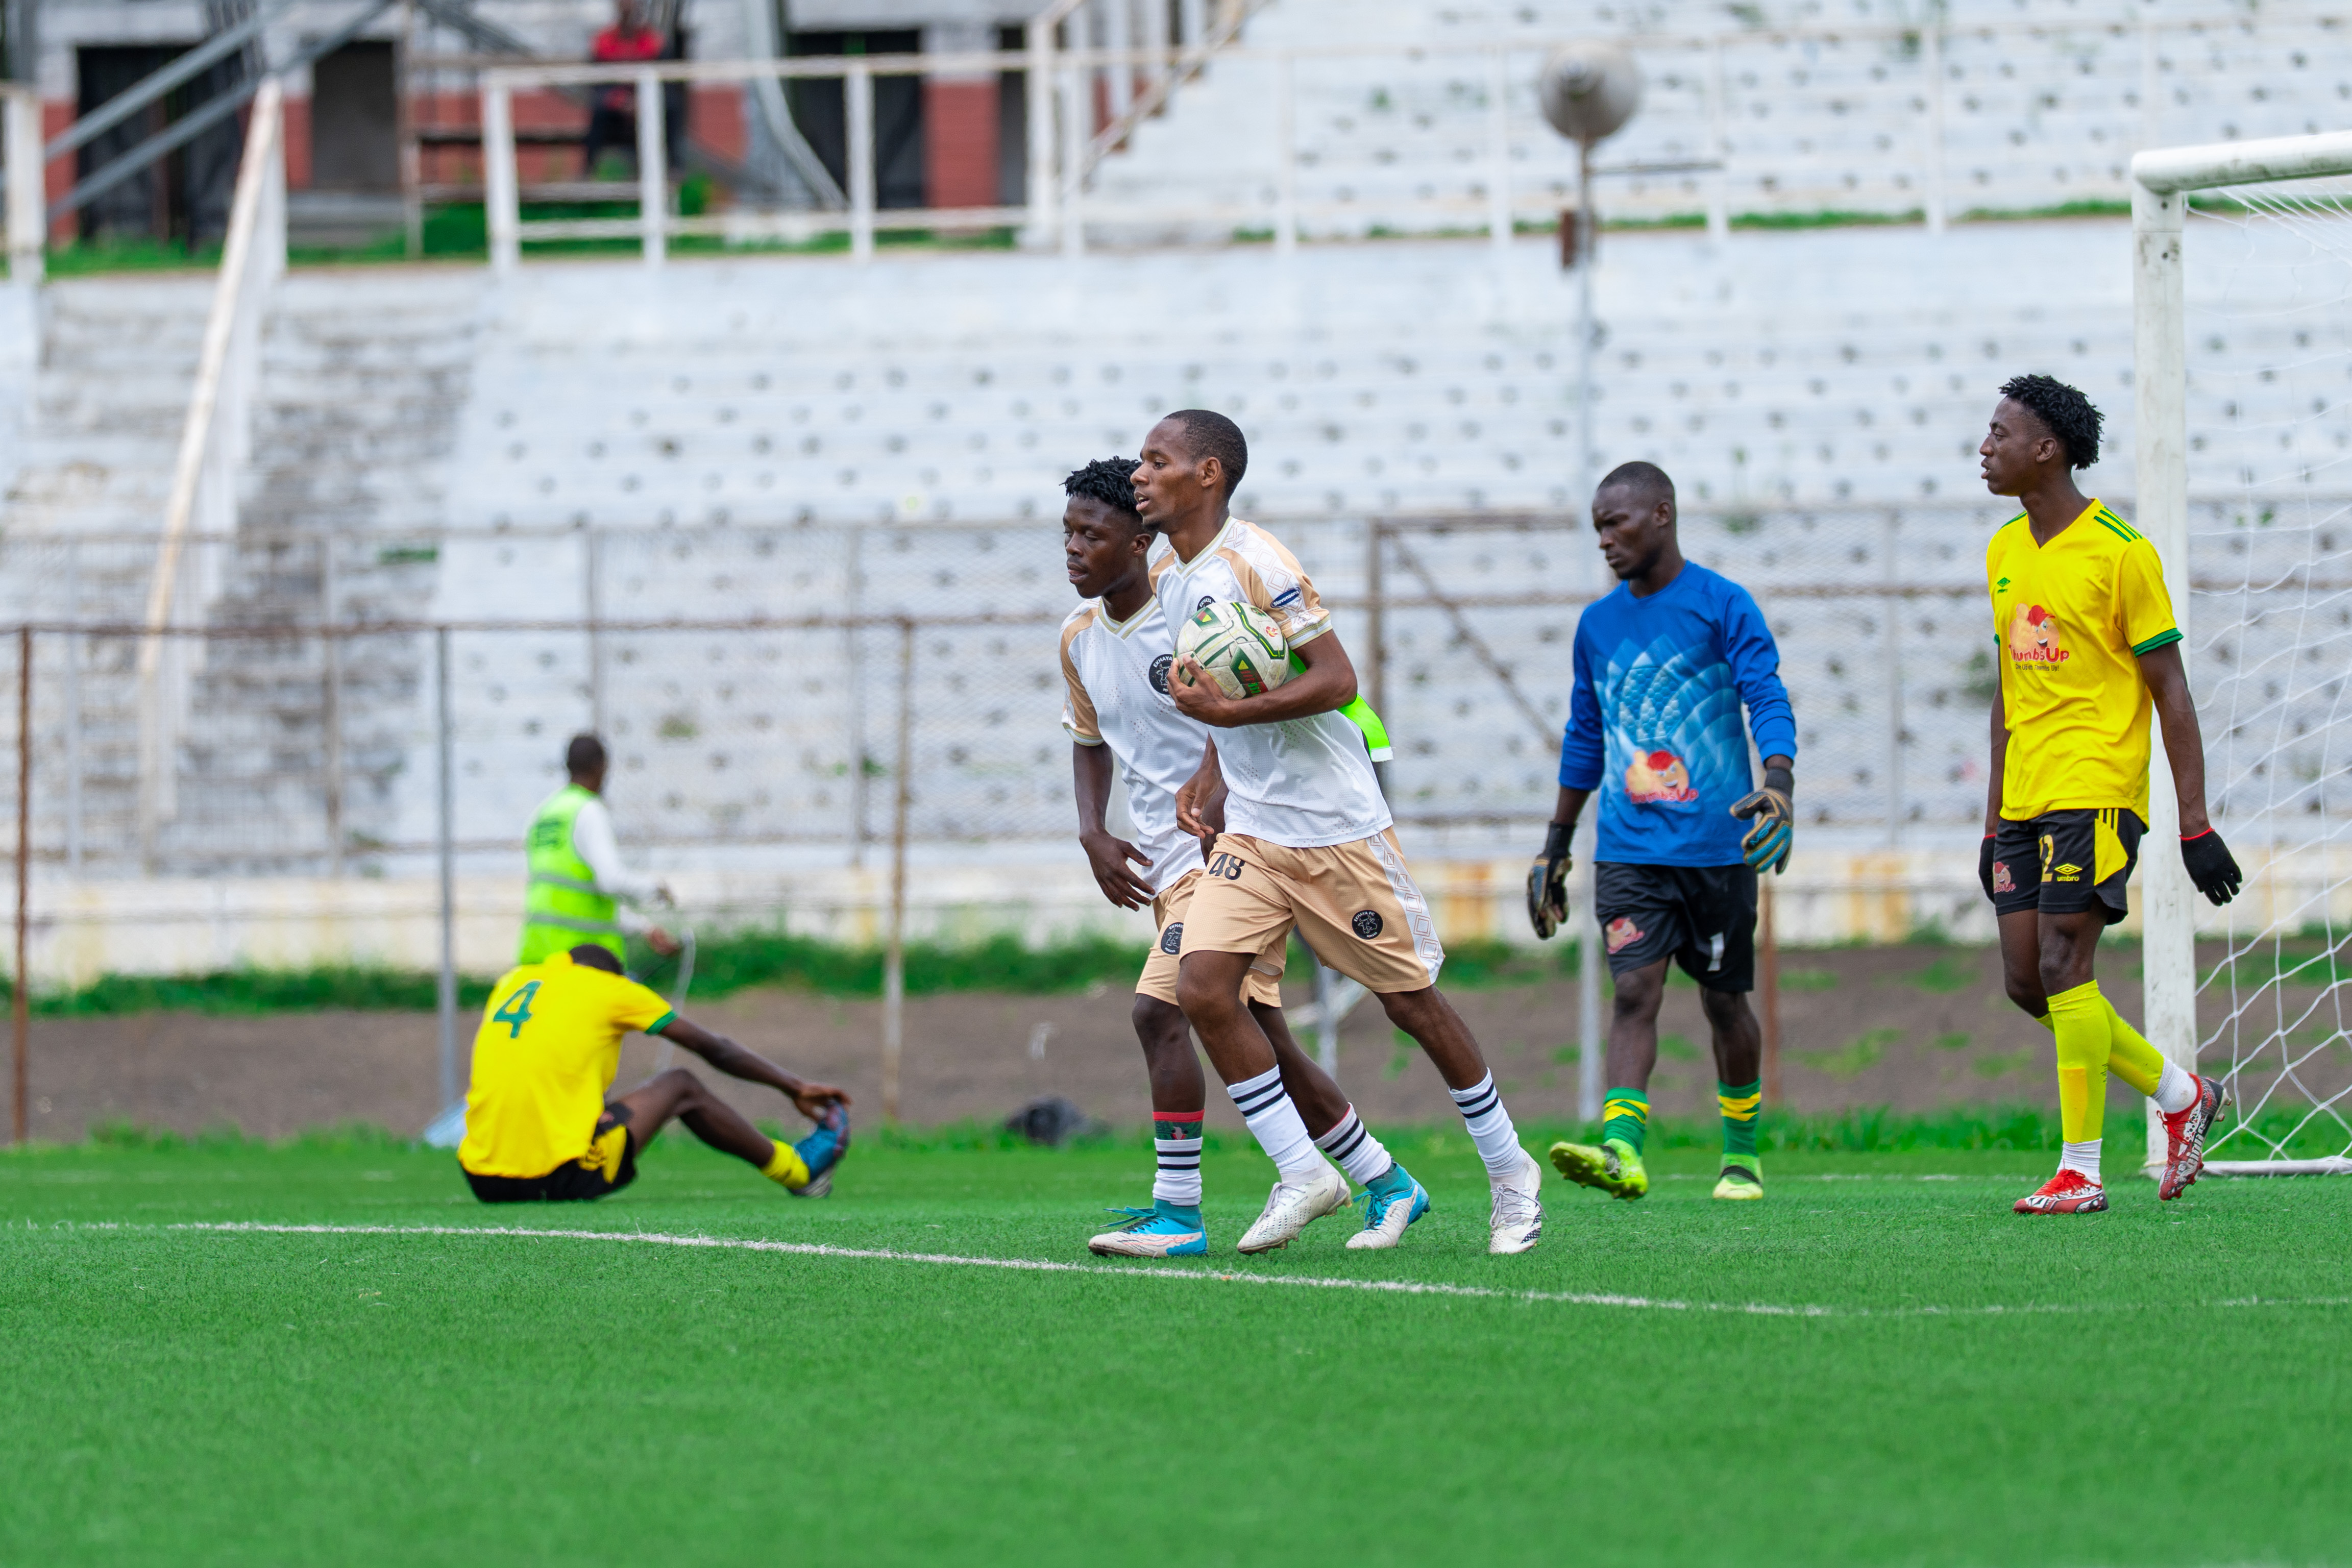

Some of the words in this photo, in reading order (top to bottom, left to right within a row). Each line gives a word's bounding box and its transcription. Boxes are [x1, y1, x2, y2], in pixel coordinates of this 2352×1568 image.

[1153, 656, 1173, 668] EKHAYA
[1209, 853, 1246, 880] 48
[1707, 931, 1725, 972] 1
[493, 981, 541, 1039] 4
